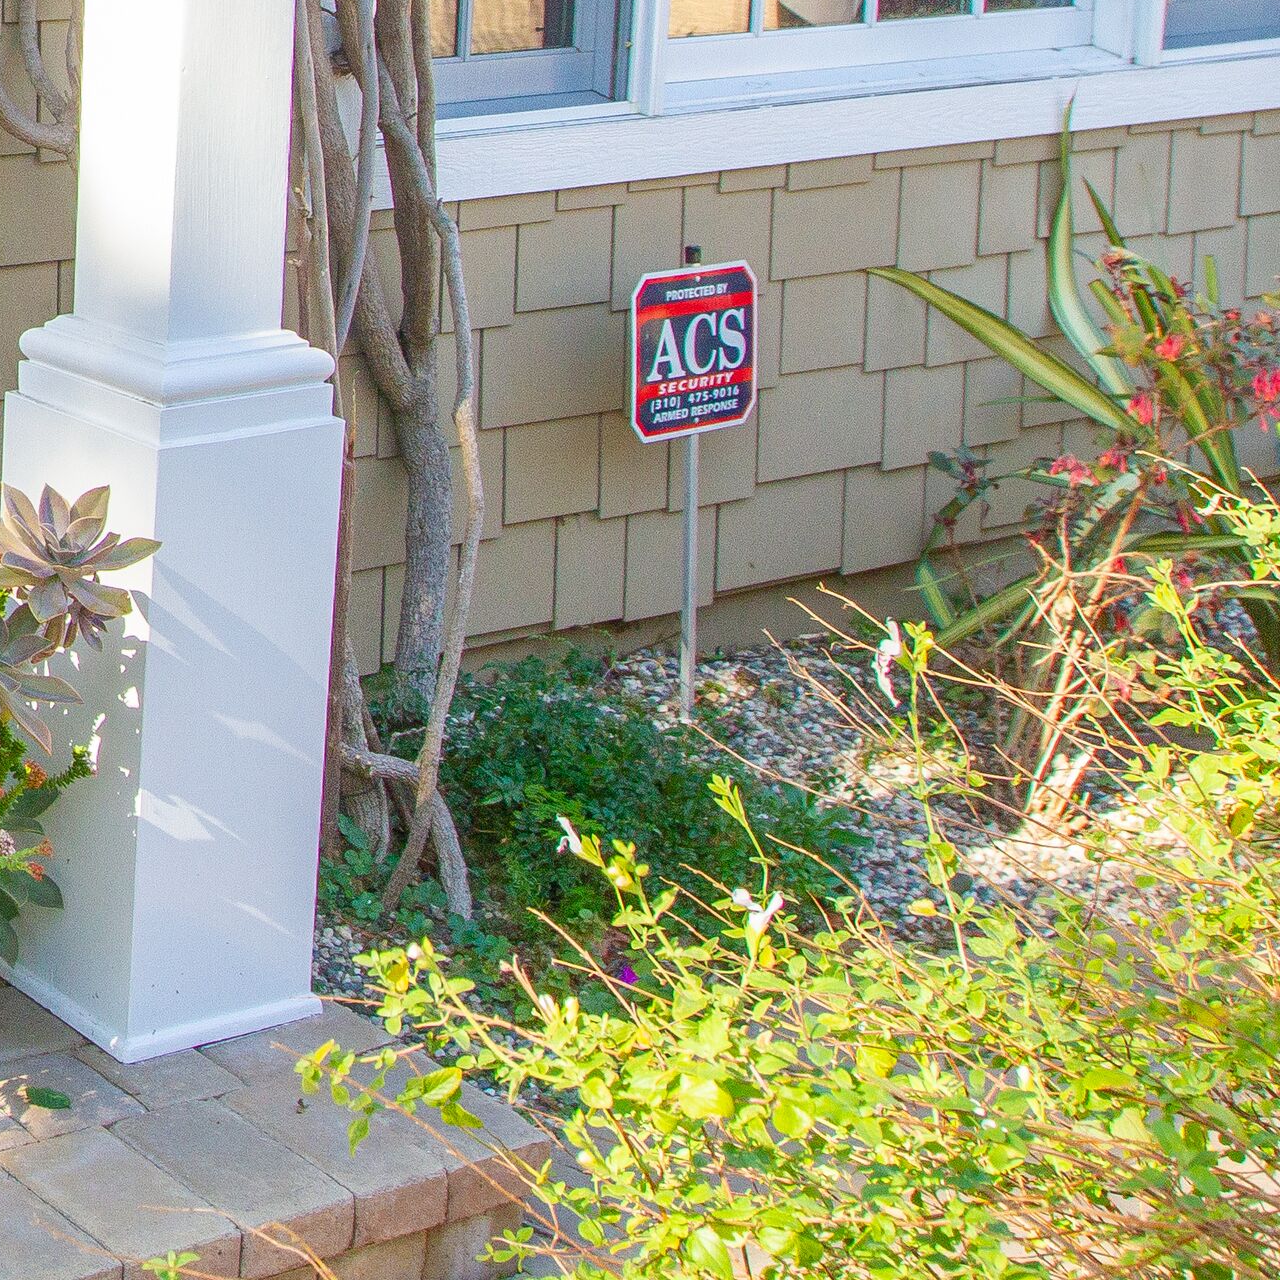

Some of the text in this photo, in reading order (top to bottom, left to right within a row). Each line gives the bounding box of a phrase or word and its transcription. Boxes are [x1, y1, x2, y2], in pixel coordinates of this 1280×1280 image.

[666, 283, 729, 301] PROTECTED BY
[646, 308, 747, 382] ACS
[658, 372, 734, 395] SECURITY
[651, 385, 740, 413] (310) 475-9016
[653, 398, 739, 424] ARMED RESPONSE
